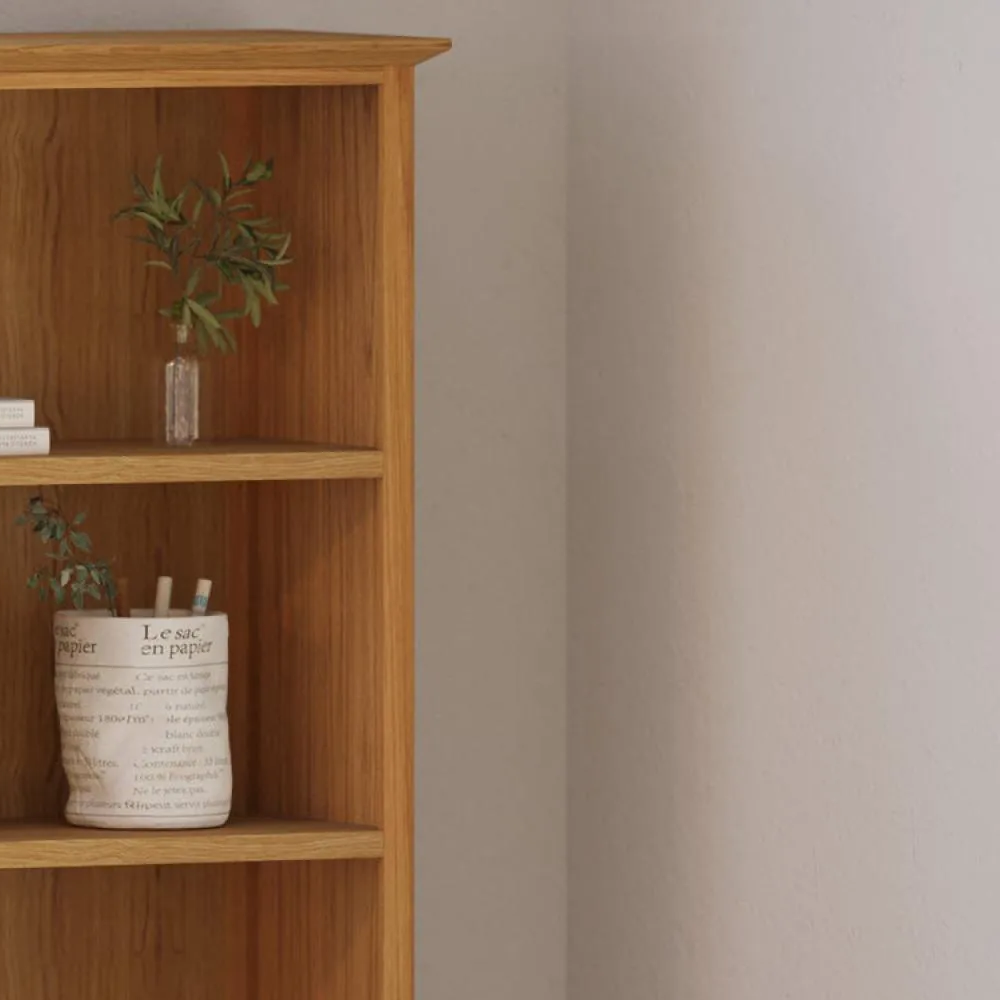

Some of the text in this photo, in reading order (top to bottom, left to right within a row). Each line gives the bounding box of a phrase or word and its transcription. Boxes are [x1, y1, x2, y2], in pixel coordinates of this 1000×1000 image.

[142, 624, 201, 640] Le sac
[140, 639, 213, 659] en papier
